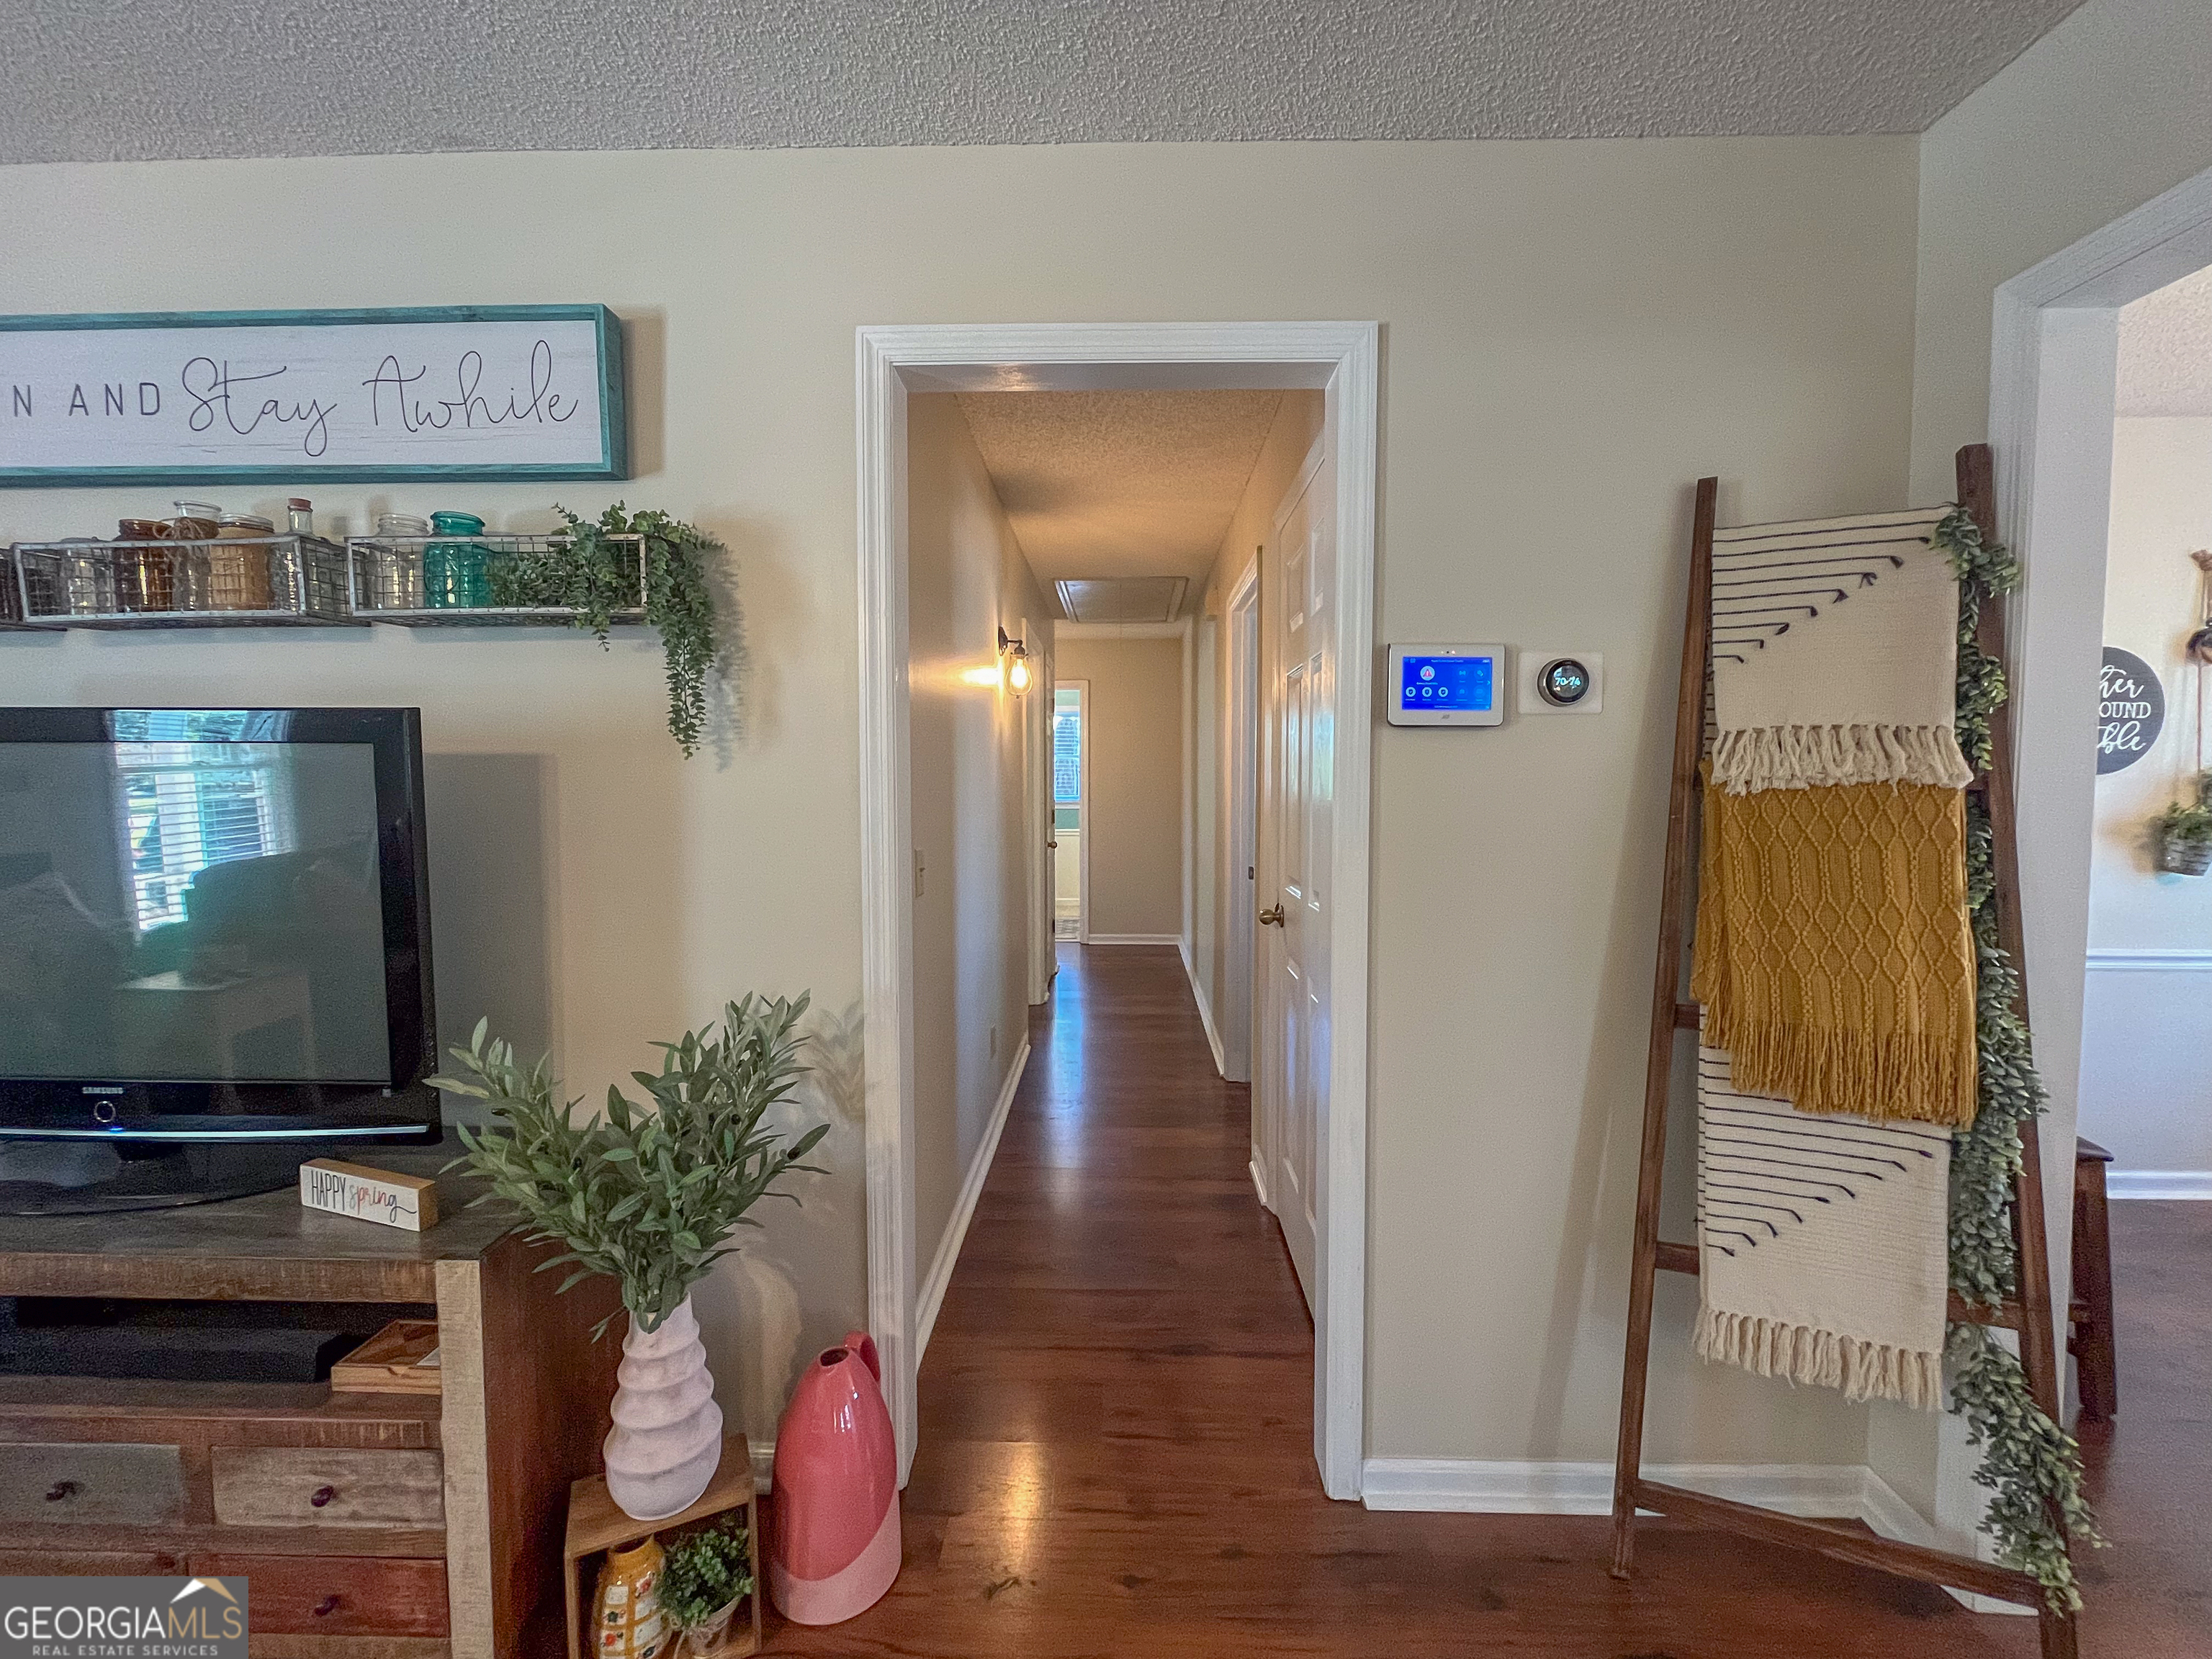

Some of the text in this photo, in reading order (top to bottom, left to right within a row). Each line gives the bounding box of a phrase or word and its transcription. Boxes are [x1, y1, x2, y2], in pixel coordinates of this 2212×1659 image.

[69, 383, 161, 416] AND
[182, 357, 338, 457] Stay
[362, 341, 578, 432] Awhile
[2100, 665, 2144, 698] her
[2099, 701, 2151, 719] OUND
[2098, 721, 2146, 754] ble
[311, 1170, 346, 1212] HAPPY
